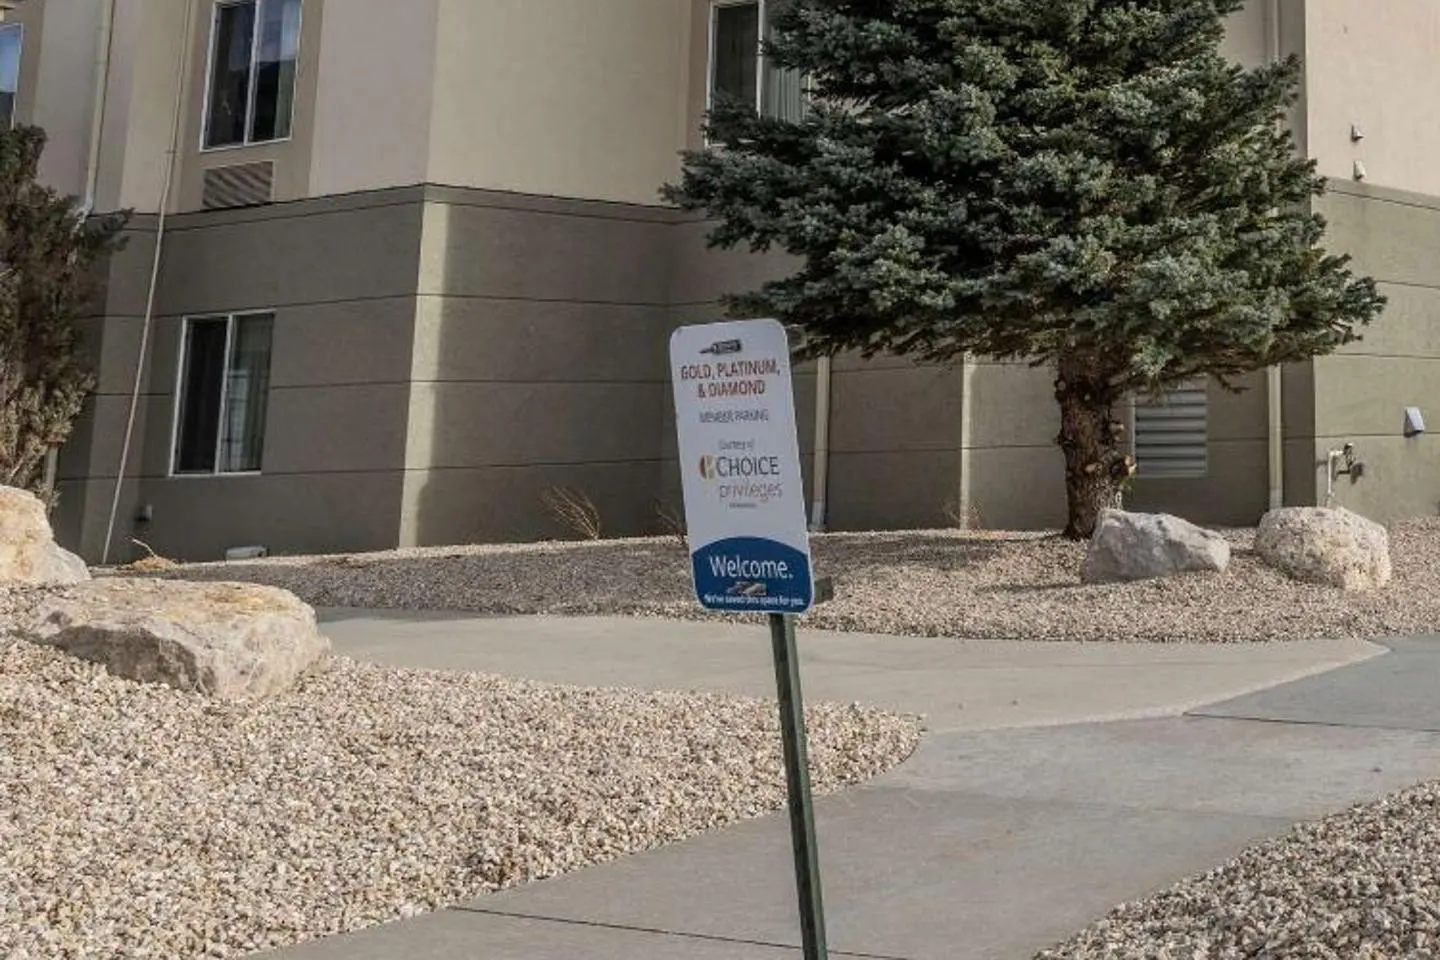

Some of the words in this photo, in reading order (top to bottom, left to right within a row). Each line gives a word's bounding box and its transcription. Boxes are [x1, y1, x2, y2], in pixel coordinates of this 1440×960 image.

[681, 363, 716, 381] GOLD,
[717, 358, 781, 378] PLATINUM,
[709, 380, 766, 398] DIAMOND
[716, 455, 781, 478] CHOICE
[719, 482, 784, 503] privileges
[709, 554, 795, 579] Welcome.
